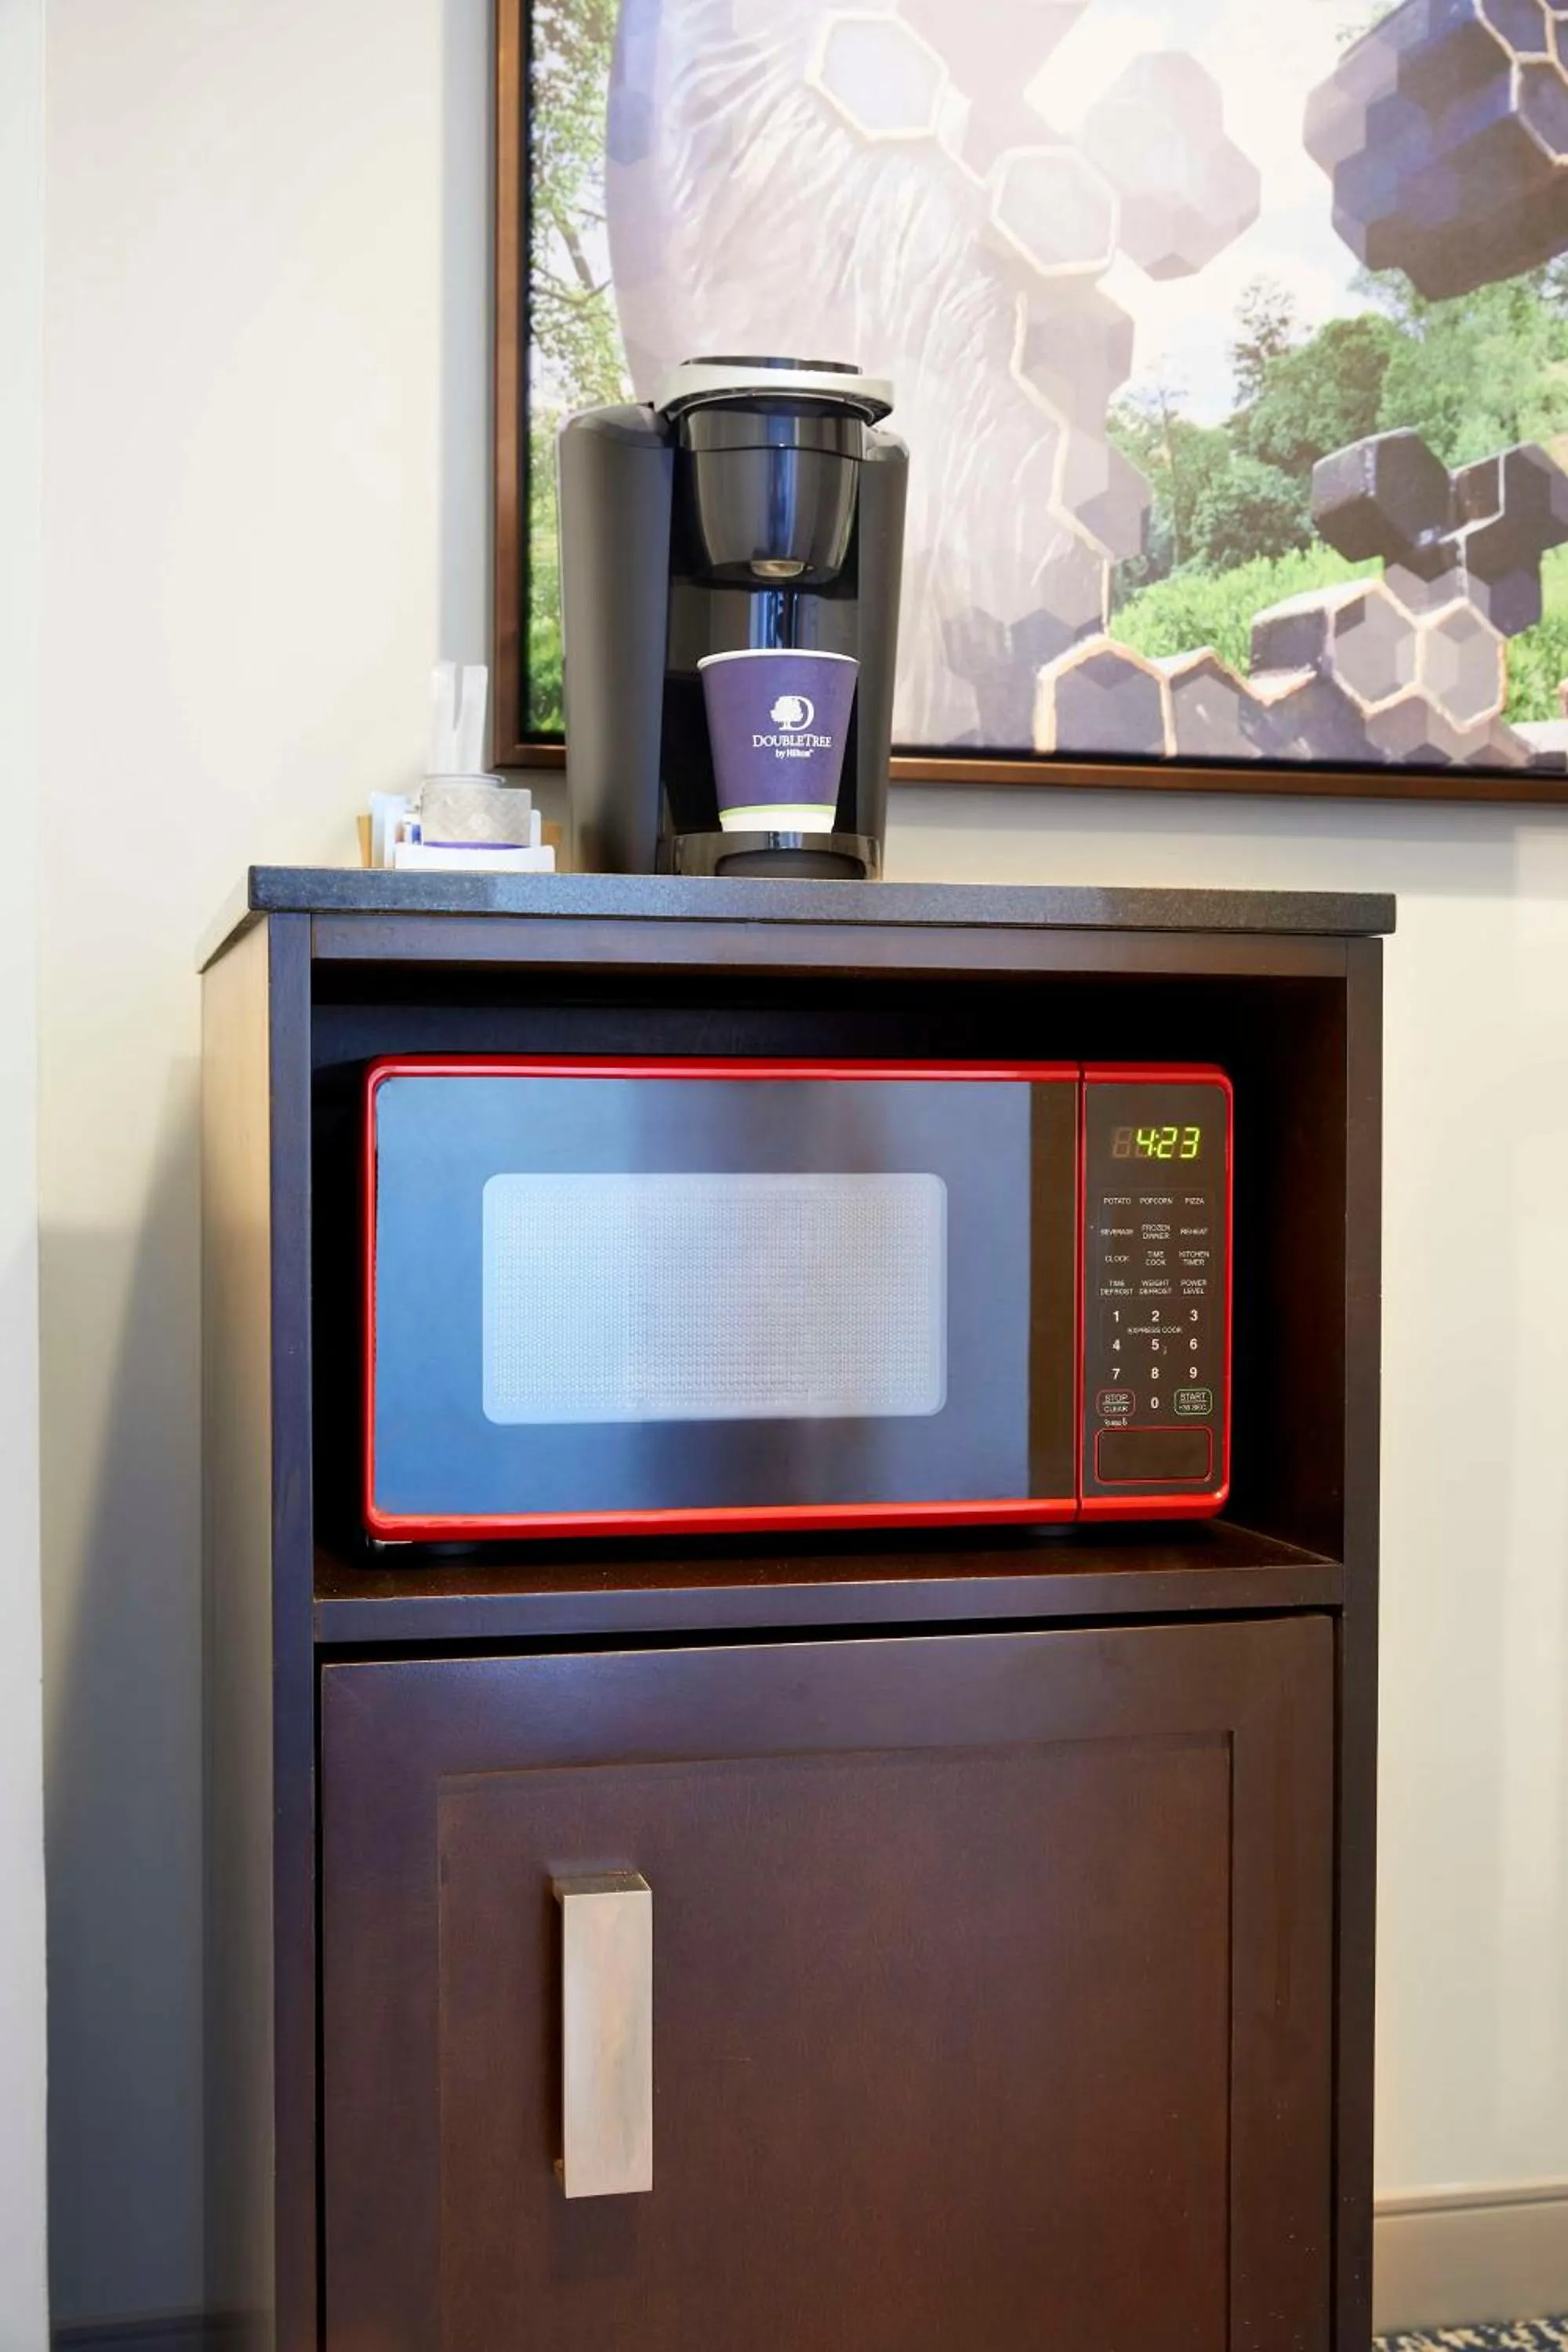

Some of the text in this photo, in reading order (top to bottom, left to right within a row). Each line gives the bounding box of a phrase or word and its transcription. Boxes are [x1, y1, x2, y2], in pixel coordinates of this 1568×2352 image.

[775, 749, 786, 759] by
[1136, 1127, 1200, 1159] 4:23
[1112, 1310, 1120, 1323] 1
[1151, 1310, 1160, 1323] 2
[1190, 1308, 1199, 1321] 3
[1112, 1339, 1121, 1351] 4
[1151, 1338, 1160, 1350] 5
[1189, 1338, 1198, 1350] 6
[1112, 1367, 1121, 1380] 7
[1151, 1367, 1160, 1379] 8
[1189, 1367, 1198, 1378] 9
[1150, 1396, 1160, 1409] 0
[1180, 1392, 1206, 1401] START
